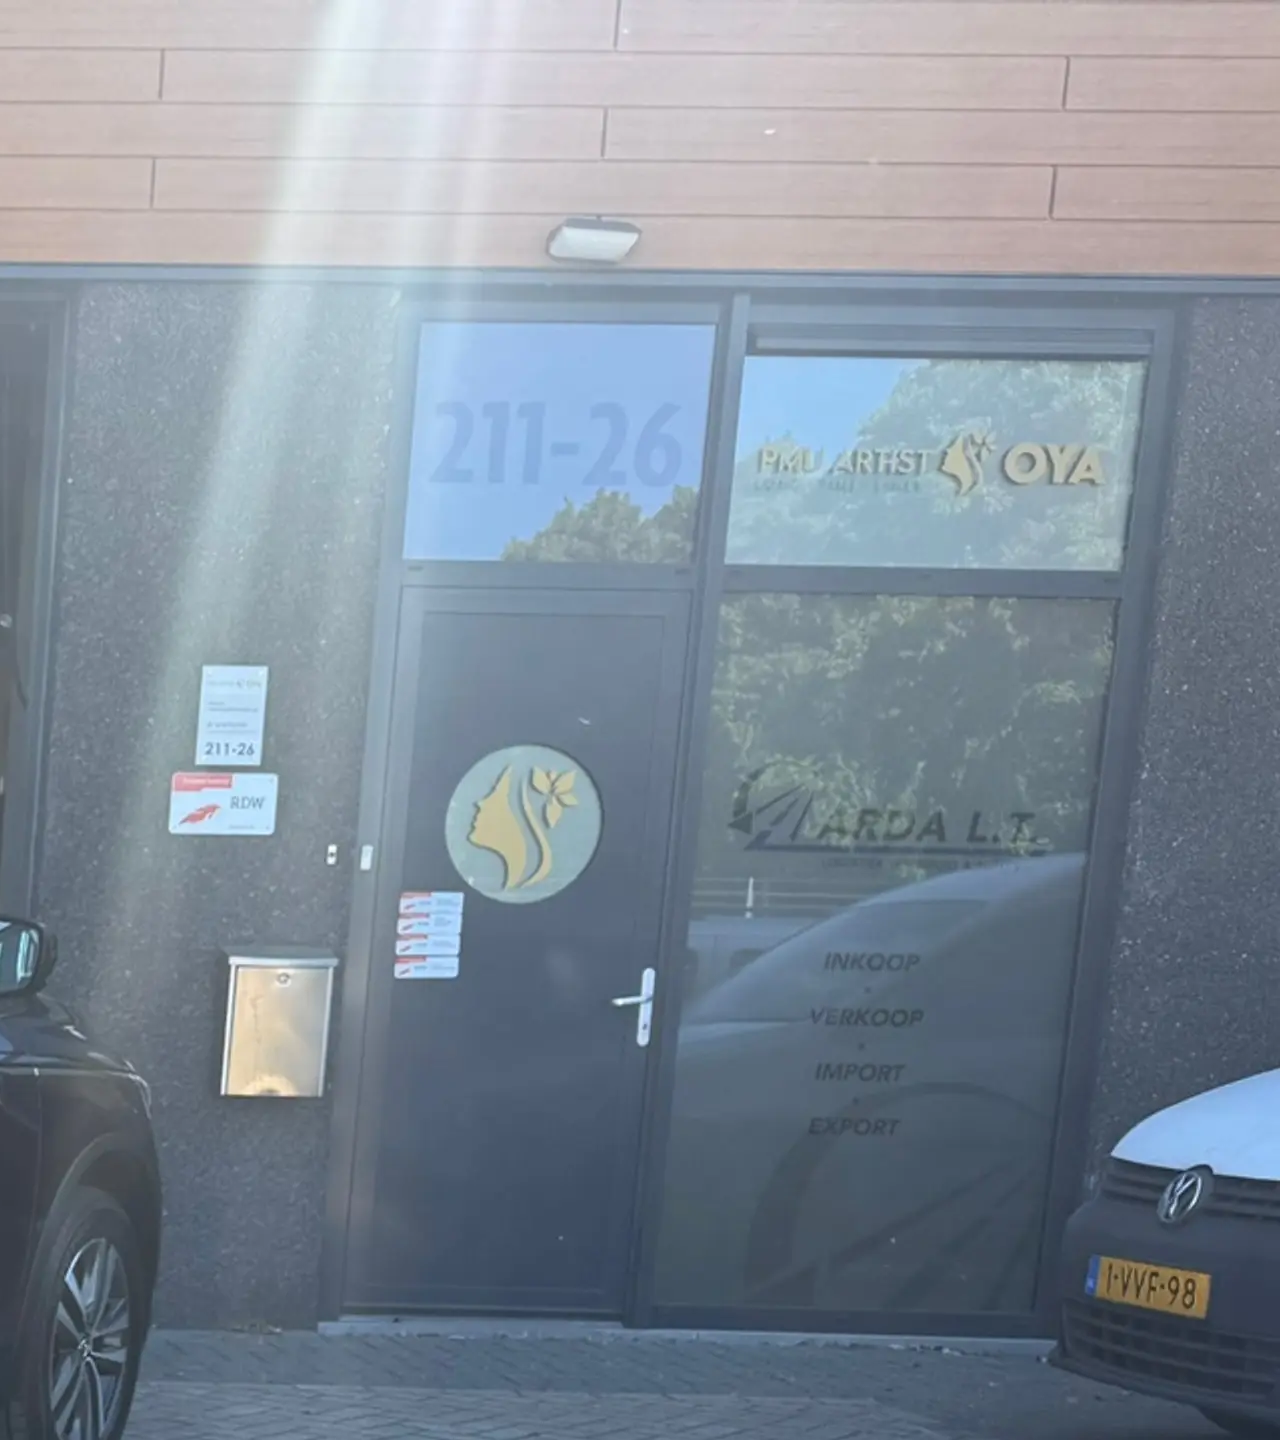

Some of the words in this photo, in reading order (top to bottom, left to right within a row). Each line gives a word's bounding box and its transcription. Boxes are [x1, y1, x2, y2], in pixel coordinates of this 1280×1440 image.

[428, 401, 683, 488] 211-26
[757, 447, 822, 475] PMU
[828, 447, 932, 476] ARTIST
[1002, 443, 1106, 487] OYA
[204, 741, 255, 757] 211-26
[229, 796, 266, 810] RDW
[816, 808, 947, 843] ARDA
[965, 809, 1050, 844] L.T.
[823, 952, 921, 972] INKOOP
[809, 1007, 925, 1028] VERKOOP
[814, 1062, 906, 1083] IMPORT
[807, 1117, 902, 1137] EXPORT
